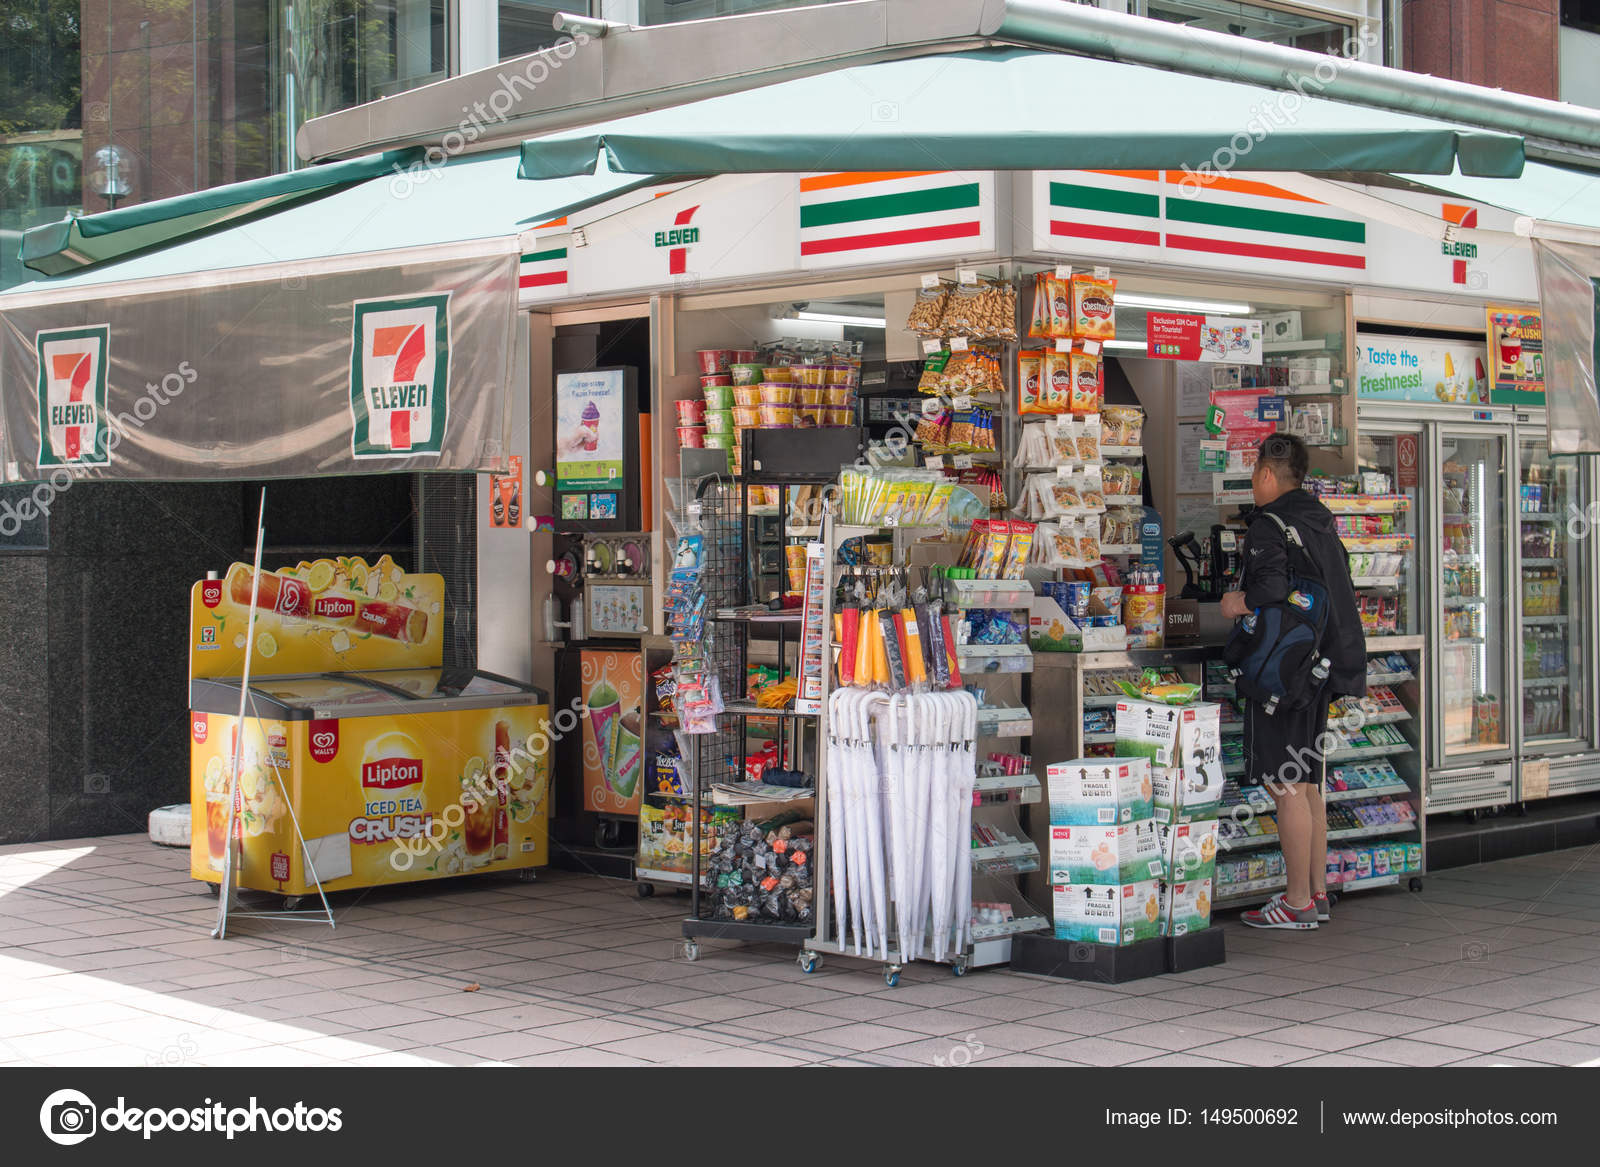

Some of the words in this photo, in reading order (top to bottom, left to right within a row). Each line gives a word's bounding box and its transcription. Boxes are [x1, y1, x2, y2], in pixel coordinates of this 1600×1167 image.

[1367, 347, 1397, 365] Taste
[1400, 349, 1418, 367] the
[1360, 369, 1423, 393] Freshness!
[318, 600, 352, 615] Lipton
[1168, 614, 1194, 625] STRAW
[1148, 722, 1169, 731] FRAGILE
[1194, 727, 1201, 747] 2
[367, 764, 418, 787] Lipton
[366, 800, 397, 816] ICED
[399, 798, 423, 812] TEA
[349, 814, 433, 843] CRUSH
